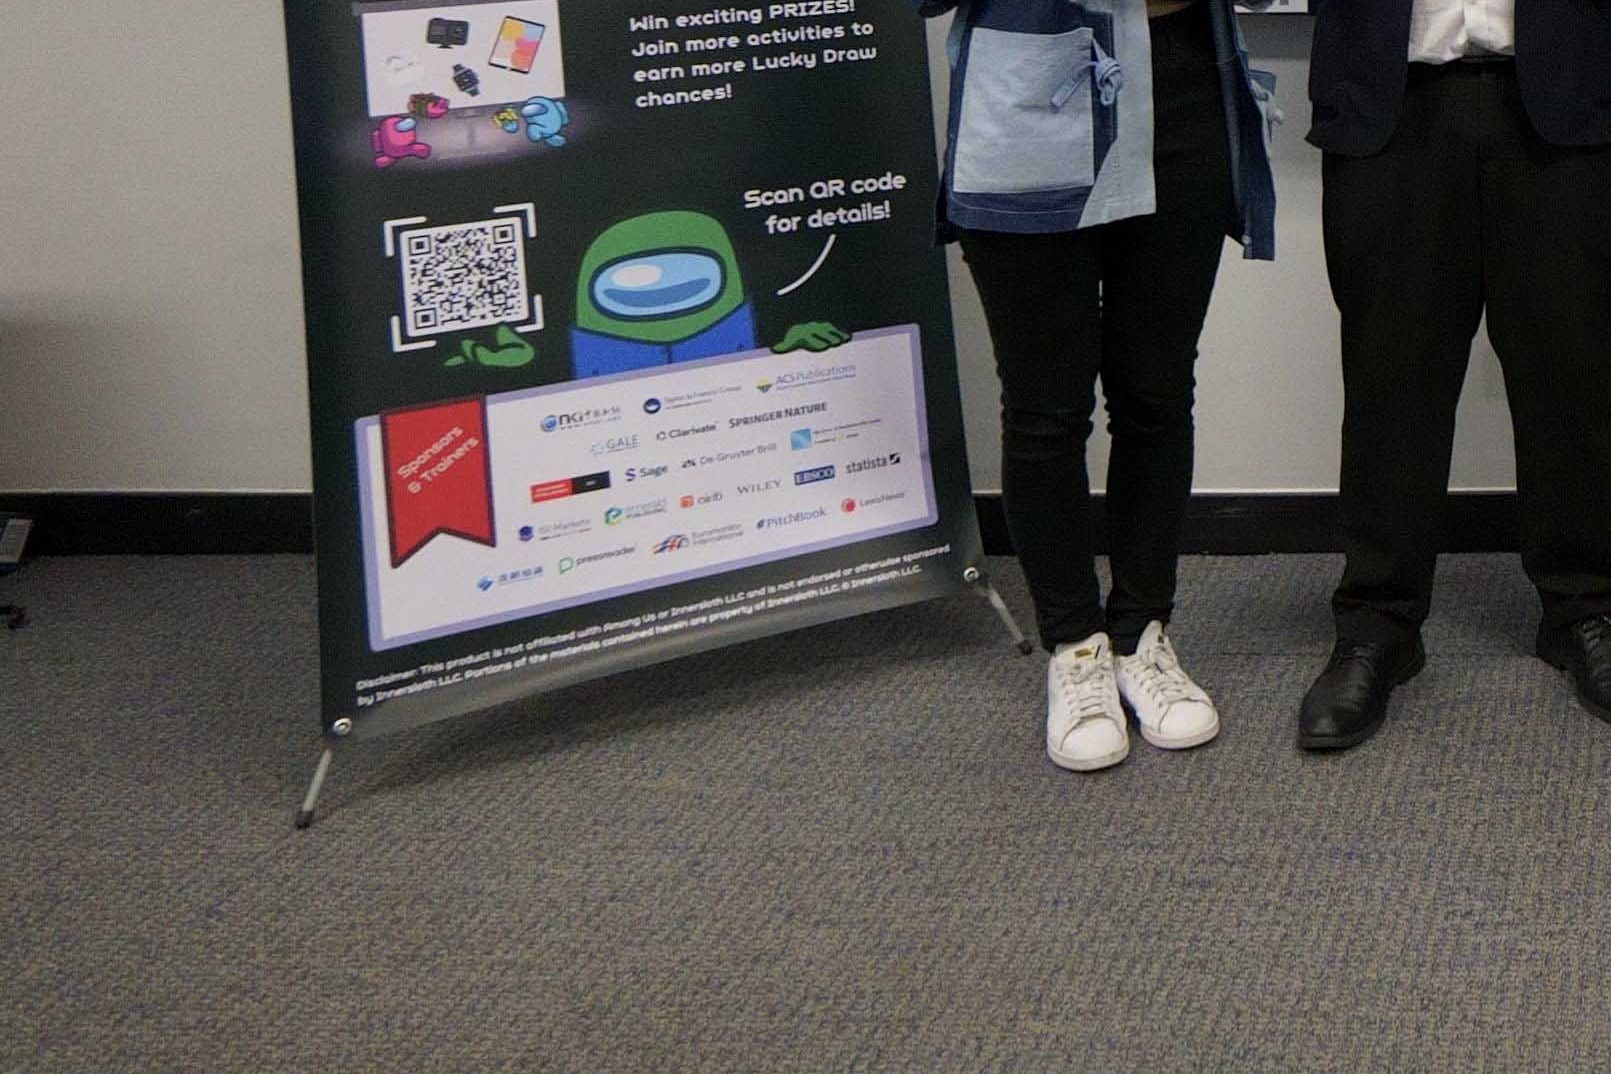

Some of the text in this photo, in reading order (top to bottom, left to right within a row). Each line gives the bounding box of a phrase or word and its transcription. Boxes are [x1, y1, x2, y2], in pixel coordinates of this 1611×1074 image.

[629, 15, 669, 32] Win
[675, 7, 763, 28] exciting
[631, 22, 875, 57] Join more activities to
[633, 46, 878, 83] earn more Lucky Draw
[635, 82, 733, 109] chances!
[744, 172, 907, 208] Scan QR code
[765, 200, 891, 234] for details!
[729, 402, 828, 428] SPRINGER NATURE
[397, 426, 464, 479] Sponsors
[606, 433, 639, 449] GALE
[420, 437, 479, 482] Trainers
[639, 466, 669, 478] Sage
[846, 456, 888, 474] statista
[737, 478, 782, 495] WILEY
[766, 506, 827, 529] PitchBook
[420, 662, 444, 675] This
[445, 651, 491, 671] product
[504, 643, 524, 655] not
[657, 610, 670, 620] or
[725, 592, 746, 604] LLC
[746, 587, 766, 599] and
[777, 580, 796, 591] not
[797, 569, 841, 588] endorsed
[854, 557, 901, 574] otherwise
[902, 543, 950, 563] sponsored
[357, 694, 375, 708] by
[528, 653, 549, 665] the
[708, 605, 753, 624] property
